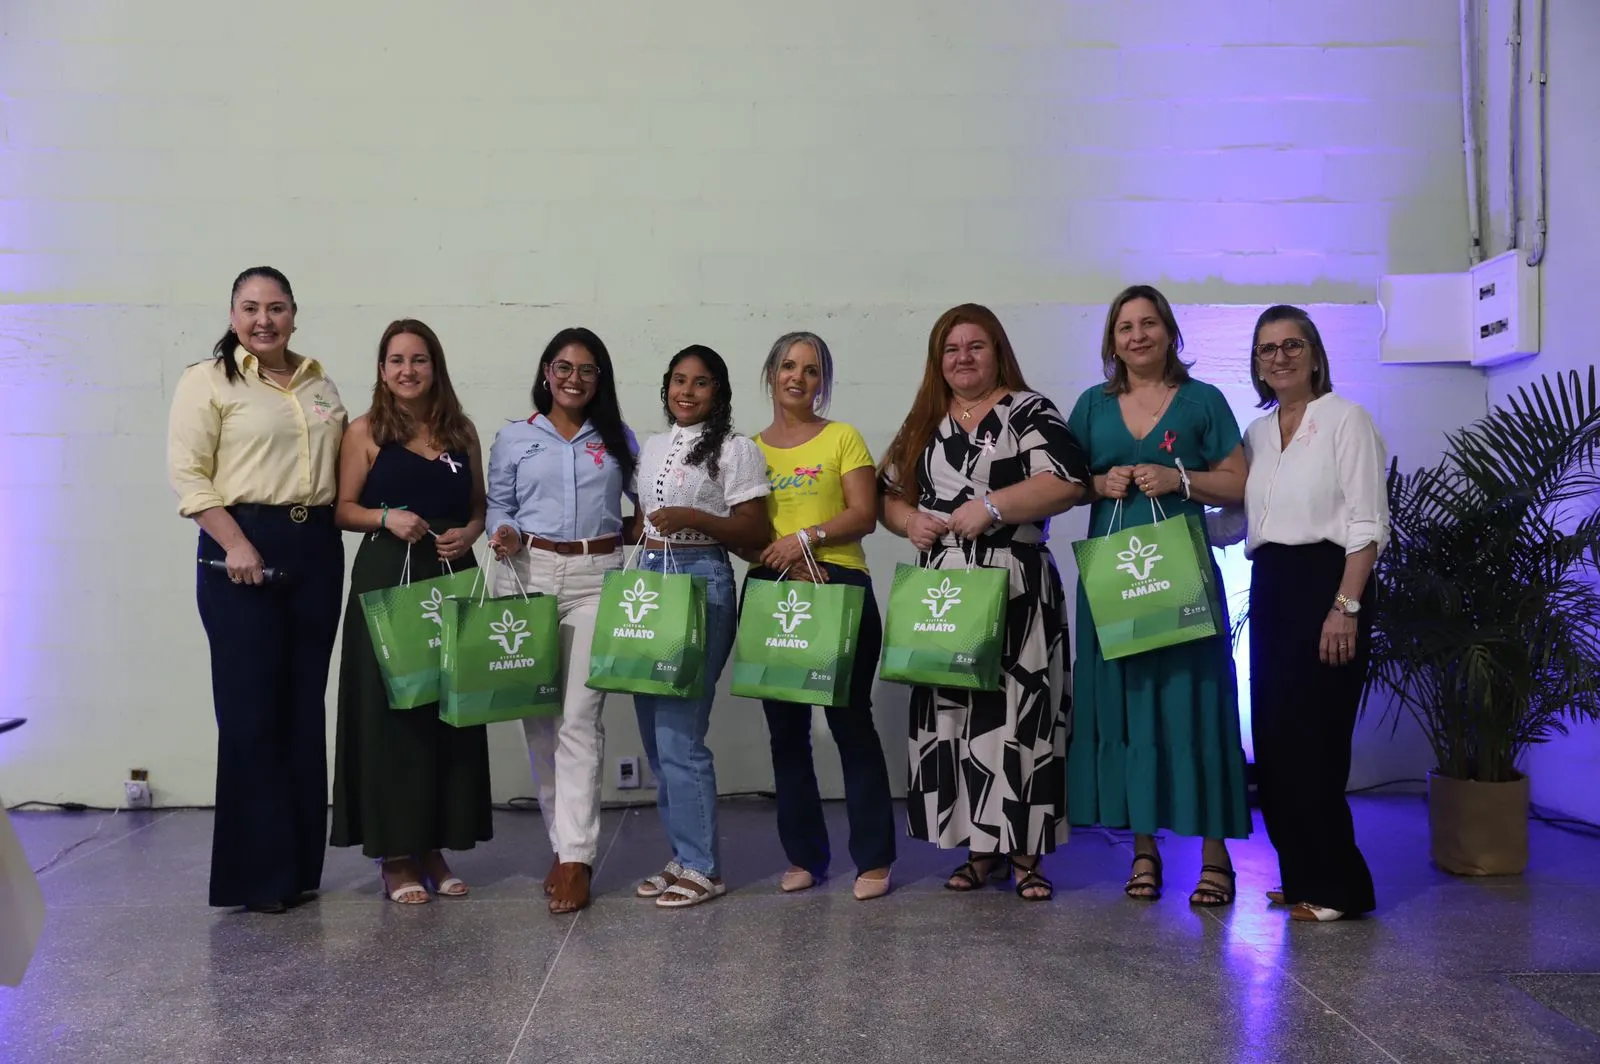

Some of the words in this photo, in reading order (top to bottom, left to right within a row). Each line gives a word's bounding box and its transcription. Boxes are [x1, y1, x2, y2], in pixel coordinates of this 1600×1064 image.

[1121, 580, 1171, 600] FAMATO
[613, 627, 655, 640] FAMATO
[913, 622, 956, 632] FAMATO
[765, 637, 809, 649] FAMATO
[488, 657, 535, 671] FAMATO
